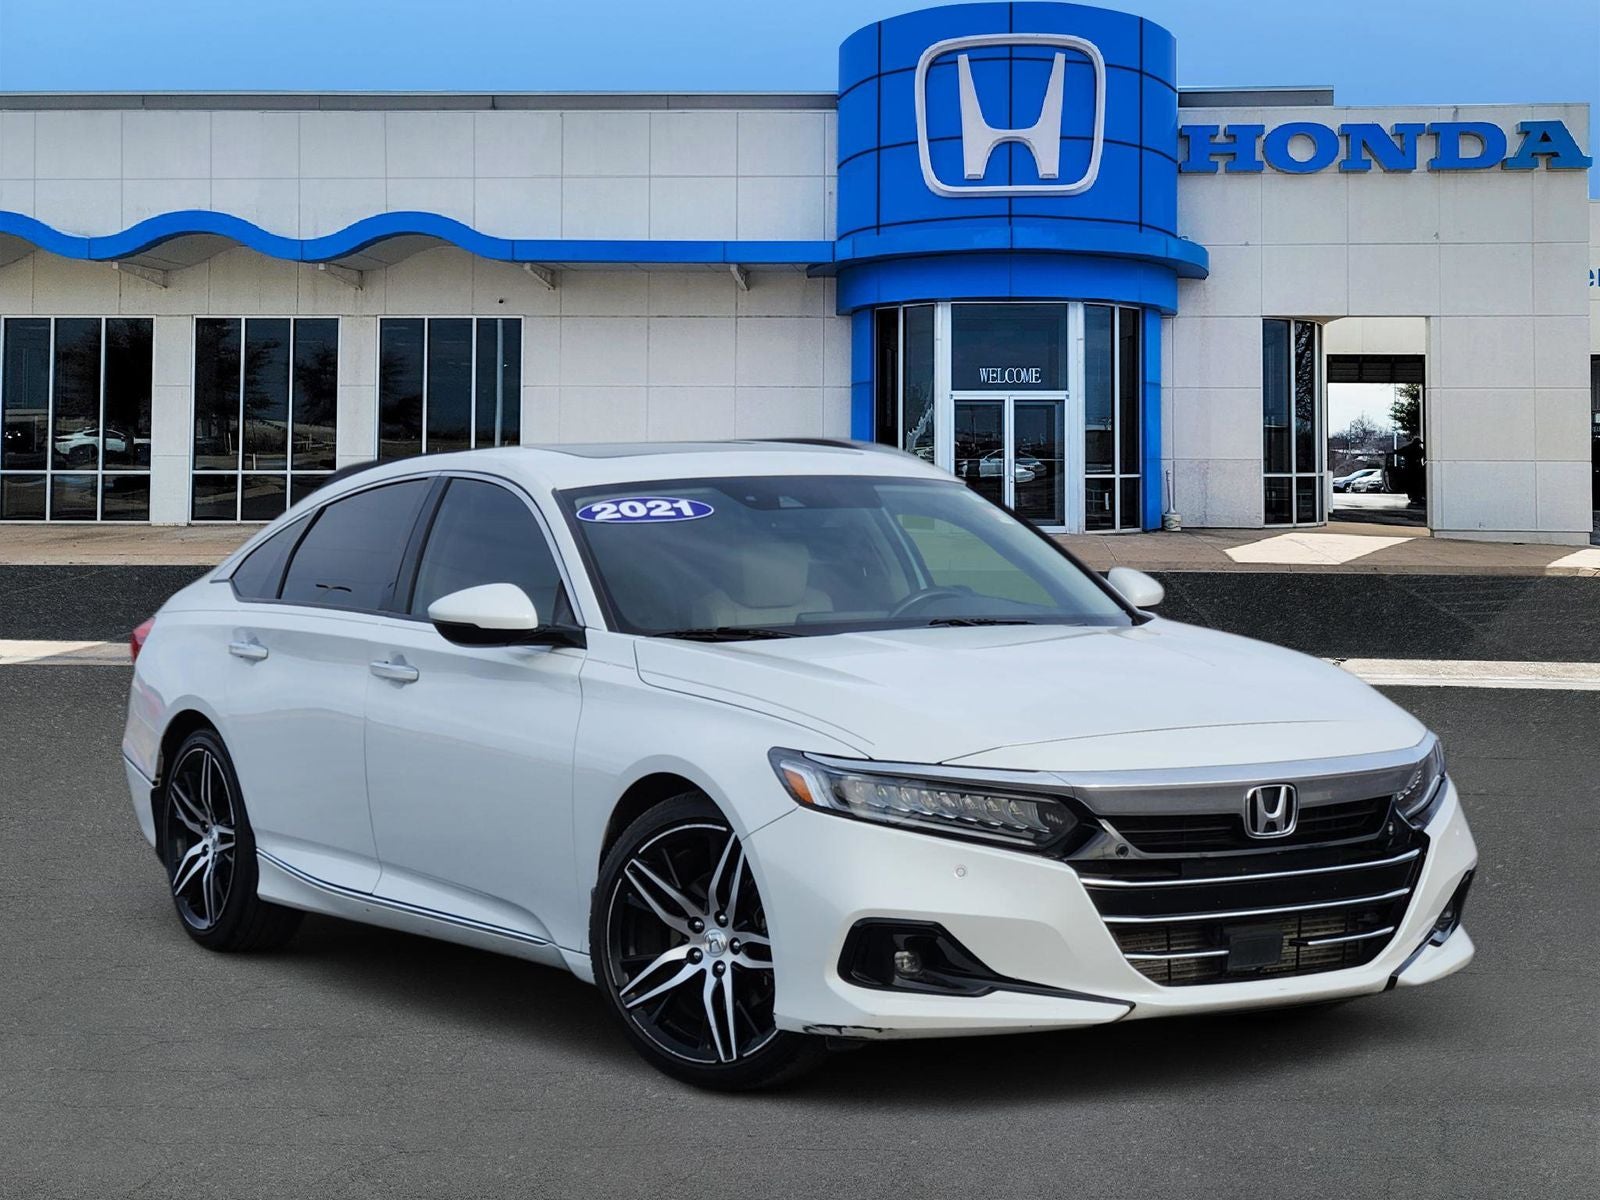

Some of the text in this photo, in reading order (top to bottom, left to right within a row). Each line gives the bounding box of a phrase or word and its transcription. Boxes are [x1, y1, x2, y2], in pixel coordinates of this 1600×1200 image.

[1179, 120, 1593, 174] HONDA
[979, 367, 1042, 384] WELCOME
[591, 499, 695, 521] 2021
